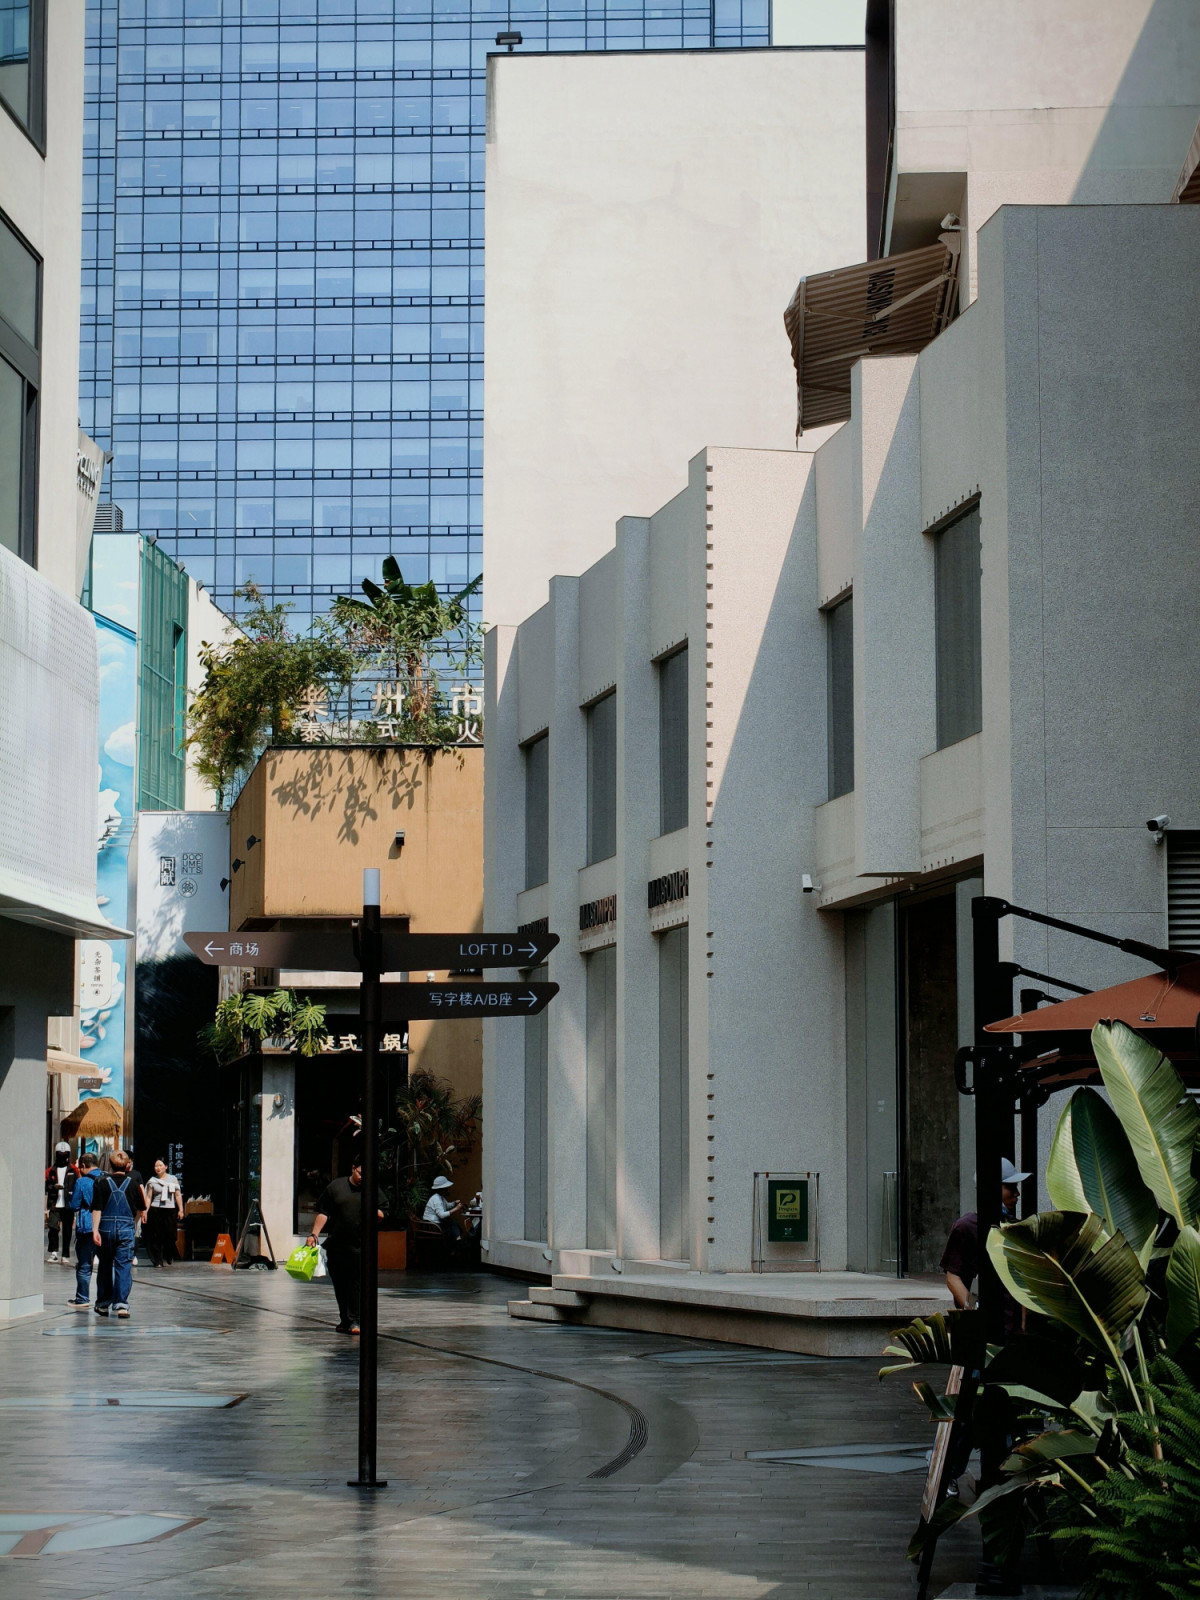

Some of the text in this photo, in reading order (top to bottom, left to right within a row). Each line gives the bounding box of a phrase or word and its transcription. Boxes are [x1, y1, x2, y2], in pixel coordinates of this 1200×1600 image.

[229, 942, 259, 956] 商场
[459, 943, 514, 956] LOFT D
[428, 992, 513, 1007] 写字楼A/B座
